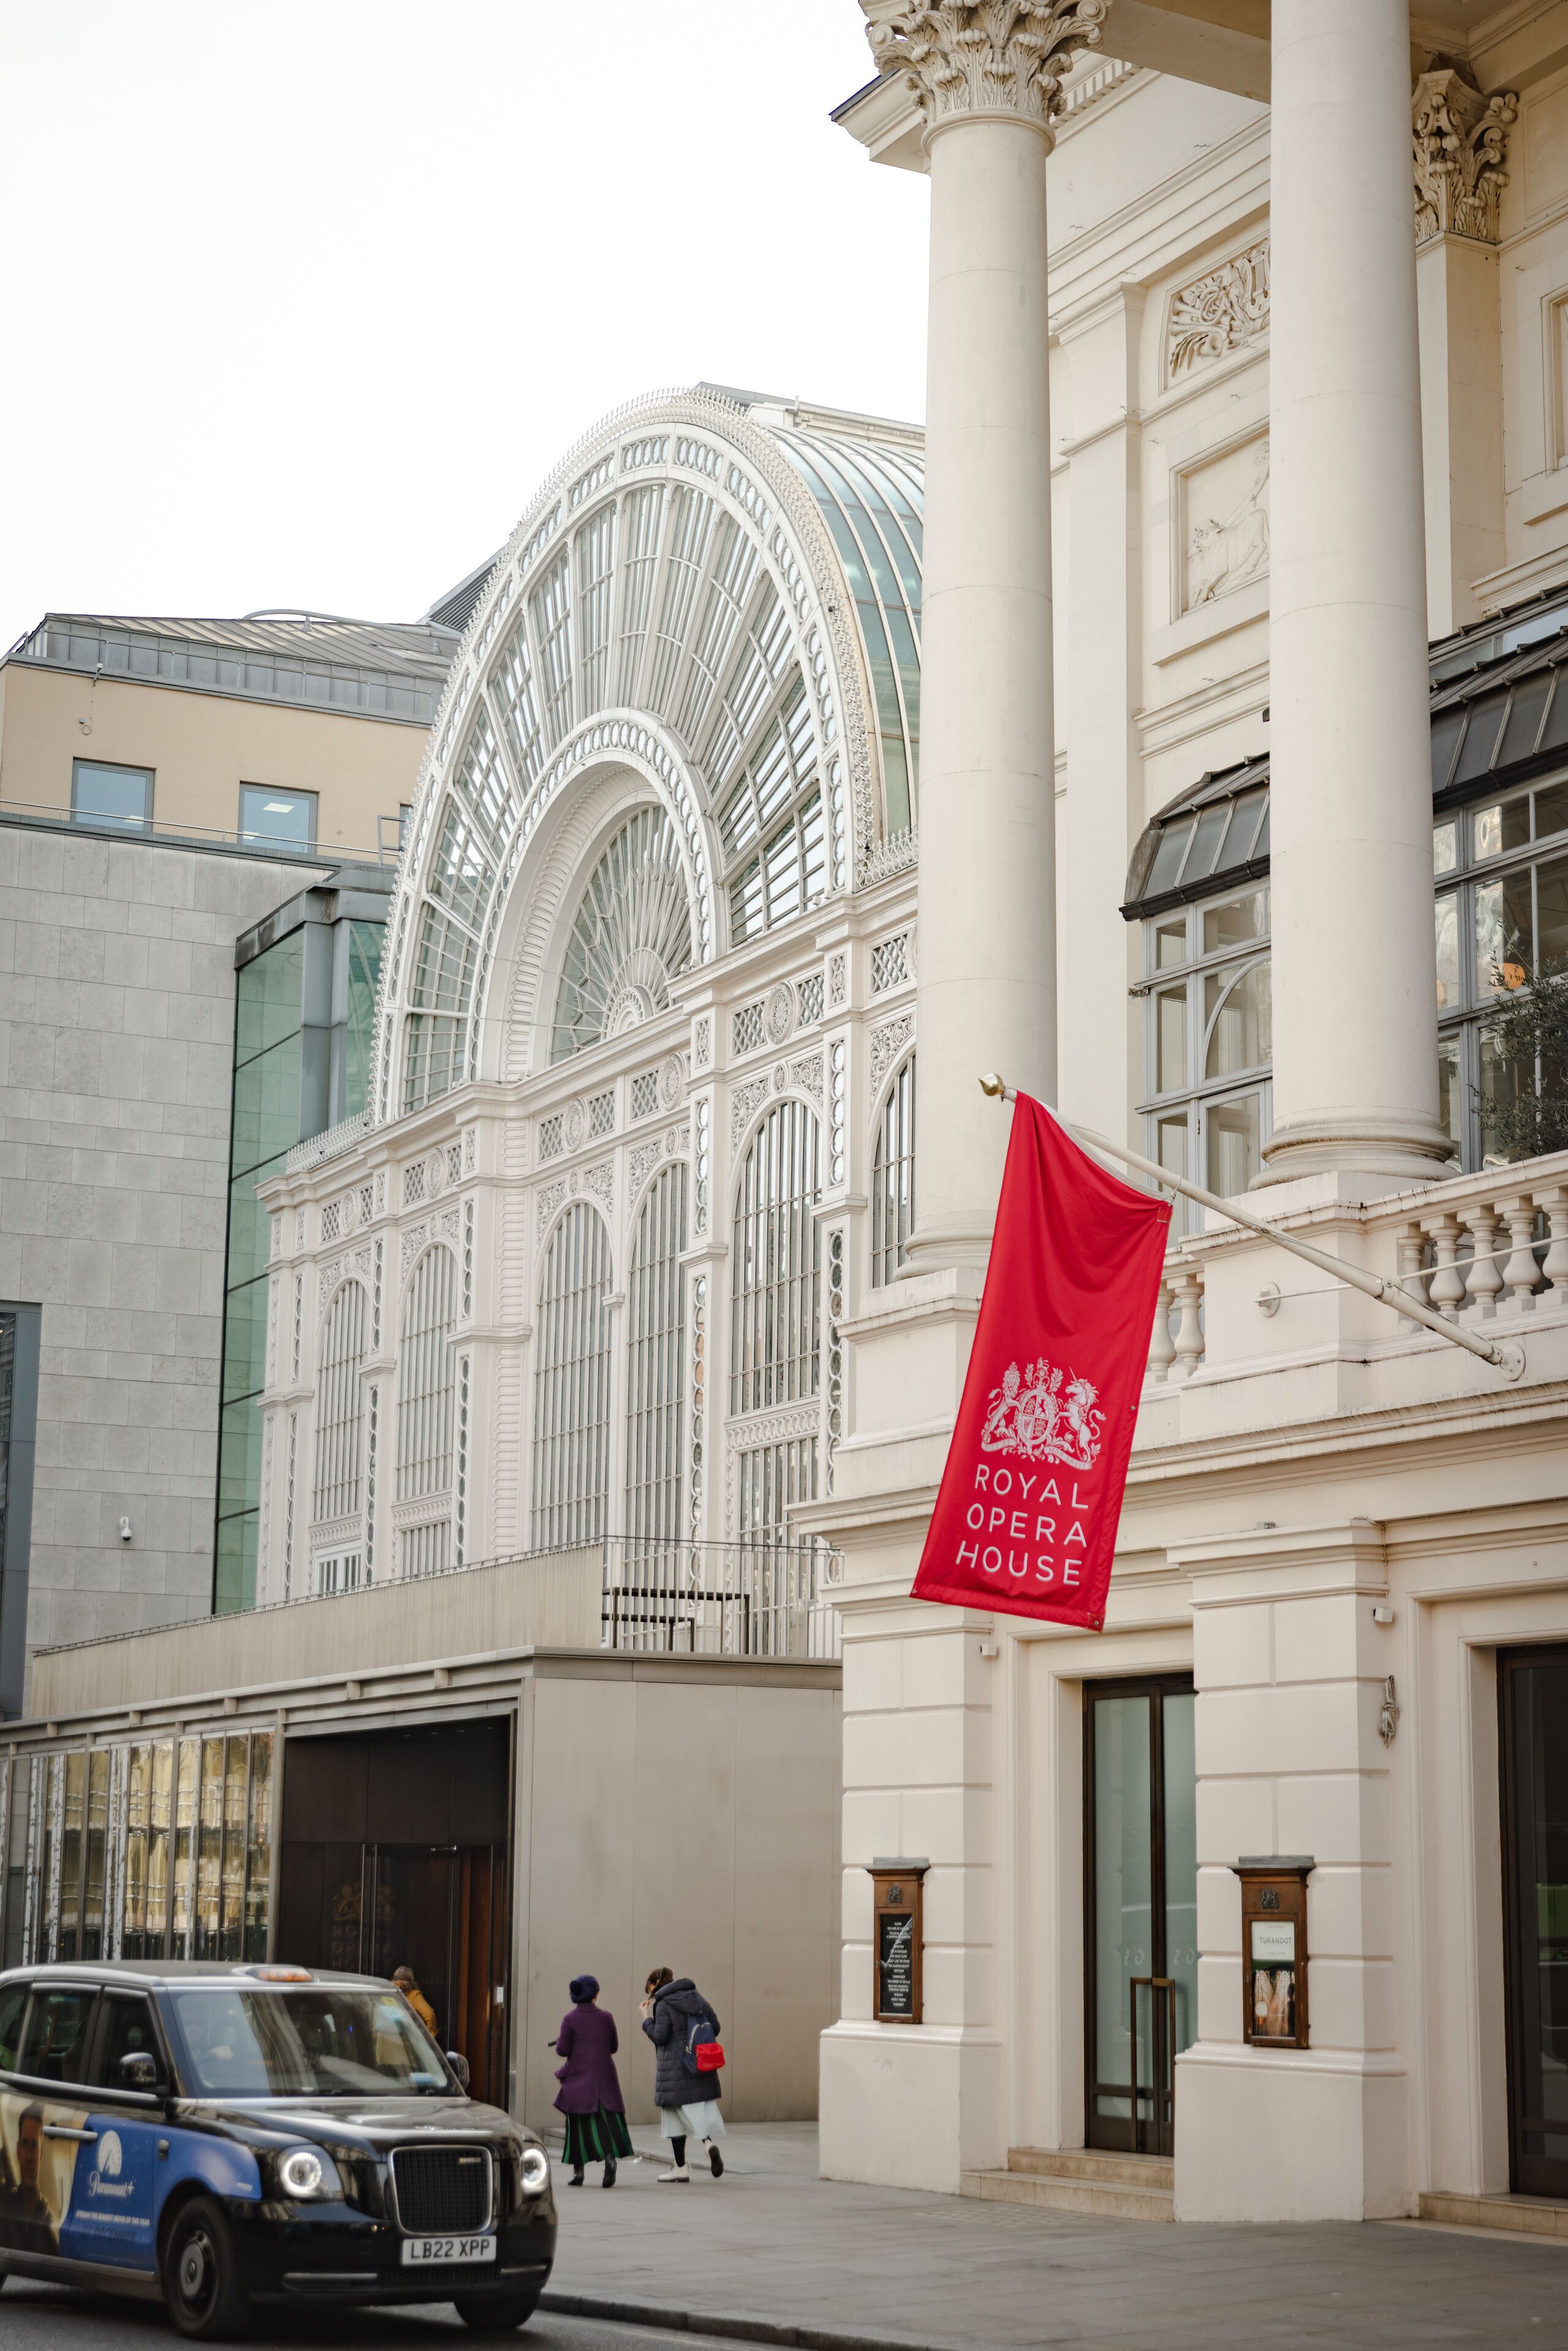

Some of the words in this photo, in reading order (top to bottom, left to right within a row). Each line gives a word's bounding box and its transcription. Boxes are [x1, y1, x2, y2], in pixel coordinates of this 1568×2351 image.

[974, 1463, 1089, 1509] ROYAL
[966, 1503, 1087, 1548] OPERA
[955, 1540, 1082, 1586] HOUSE
[411, 2241, 454, 2259] LB22
[459, 2239, 490, 2257] XPP
